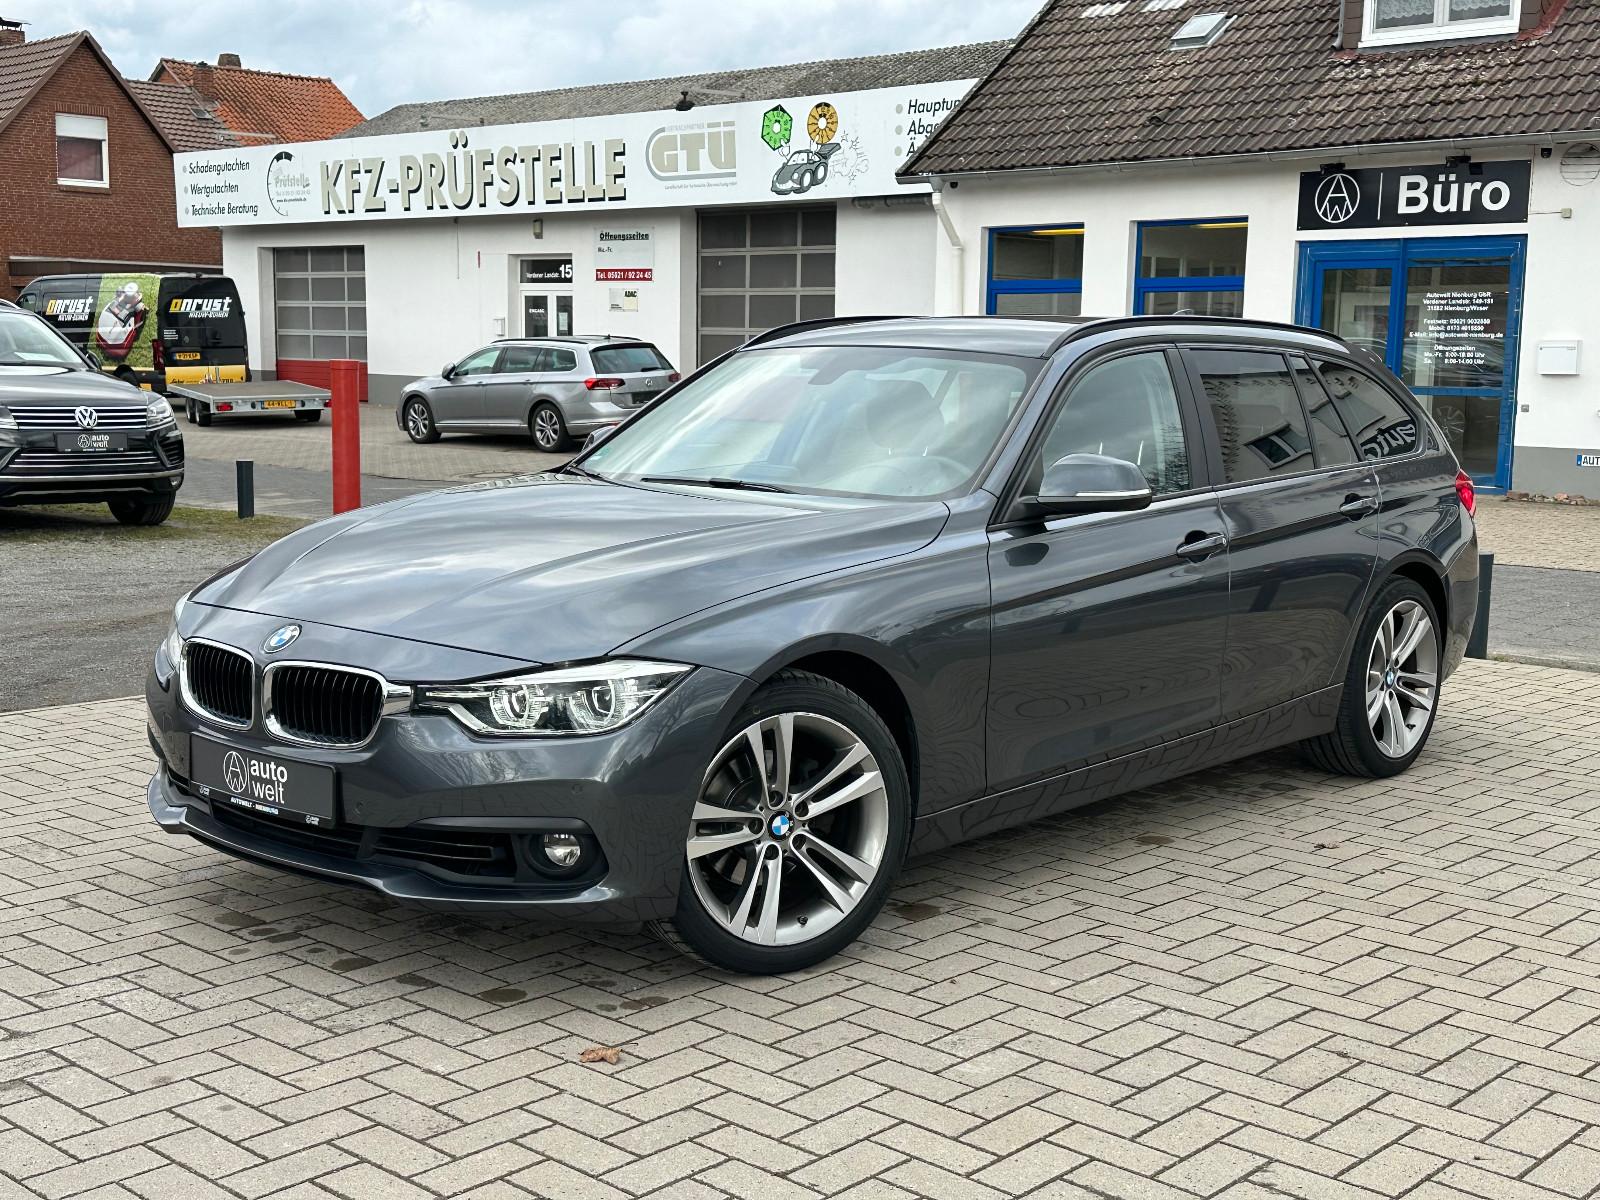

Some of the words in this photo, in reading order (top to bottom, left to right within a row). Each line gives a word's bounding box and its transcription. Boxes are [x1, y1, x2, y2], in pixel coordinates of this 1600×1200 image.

[651, 120, 736, 173] GTÜ
[189, 158, 250, 176] Schadengutachten
[319, 129, 627, 215] KFZ-PRÜFSTELLE
[190, 180, 239, 198] Wertgutachten
[1398, 173, 1511, 214] Büro
[191, 202, 225, 216] Technische
[227, 202, 258, 217] Beratung
[559, 264, 573, 279] 15
[250, 759, 288, 782] auto
[252, 780, 285, 804] welt
